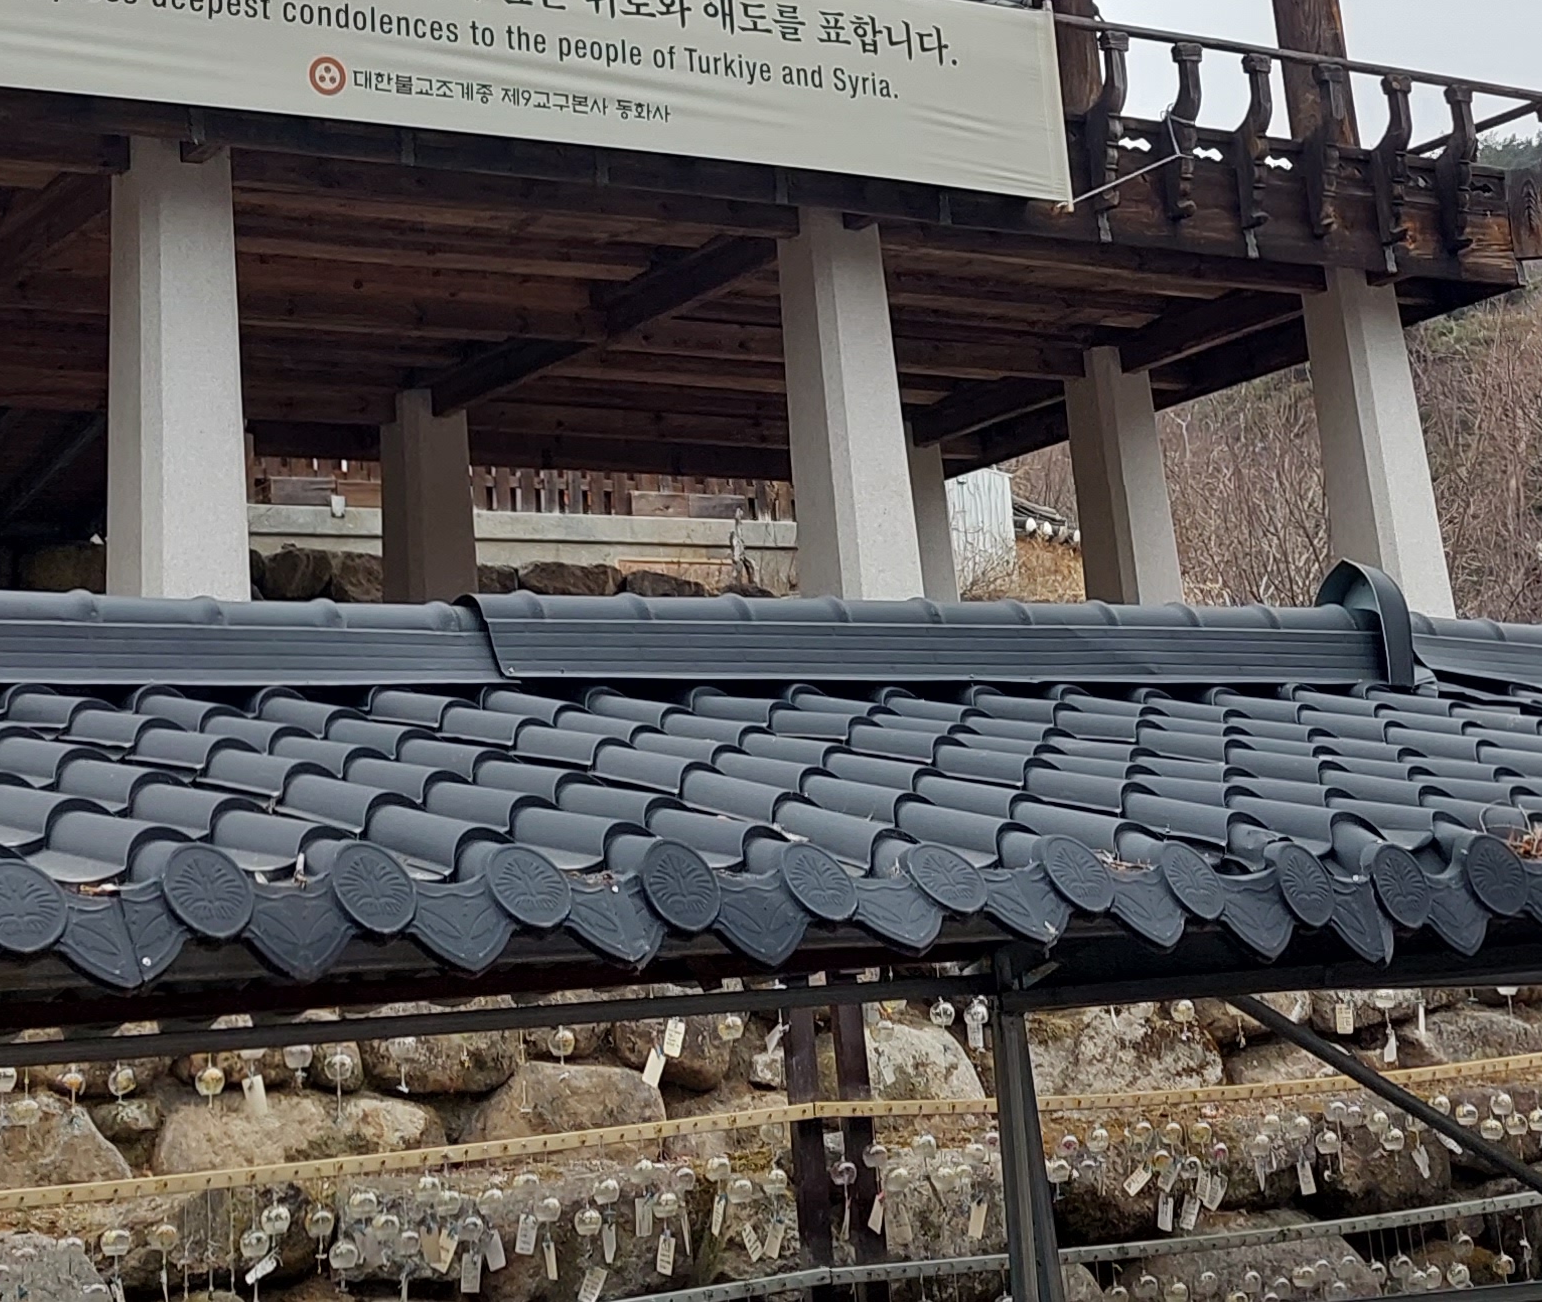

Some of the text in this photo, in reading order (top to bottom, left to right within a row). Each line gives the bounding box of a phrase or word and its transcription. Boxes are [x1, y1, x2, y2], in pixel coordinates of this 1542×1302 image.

[283, 2, 458, 42] condolences
[470, 21, 494, 47] to
[506, 26, 545, 53] the
[559, 37, 641, 67] people
[654, 46, 675, 69] of
[684, 48, 771, 85] Turkiye
[782, 65, 822, 88] and
[833, 68, 898, 98] Syria.
[818, 11, 957, 65] 표합니다.
[353, 71, 670, 122] 대한불교조계종 제9교구본사 동화사
